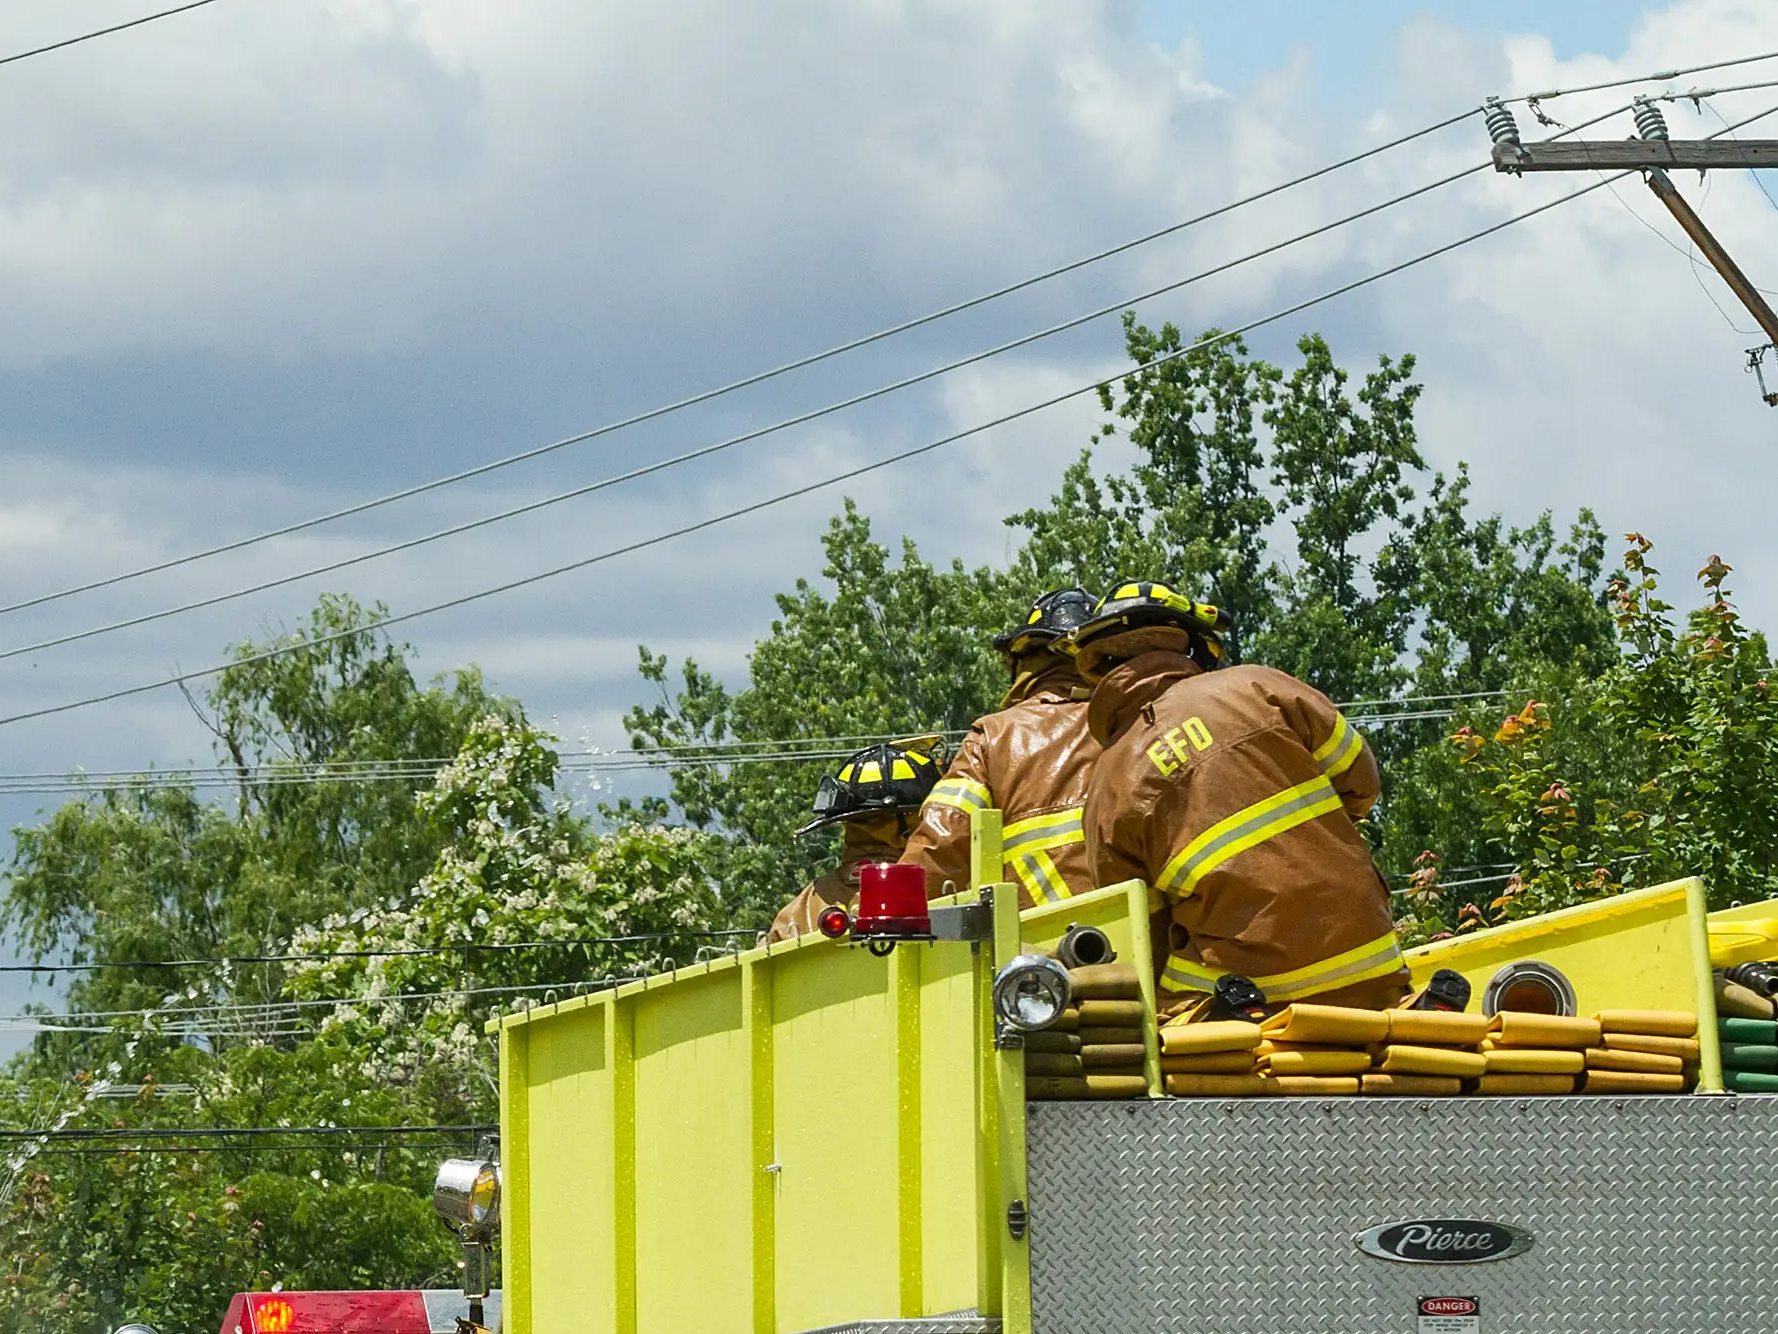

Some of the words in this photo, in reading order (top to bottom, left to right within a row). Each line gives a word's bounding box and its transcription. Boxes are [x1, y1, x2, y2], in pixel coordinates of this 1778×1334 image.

[1147, 717, 1213, 776] EFD
[1395, 1224, 1494, 1256] Pierce
[1427, 1302, 1471, 1311] DANGER
